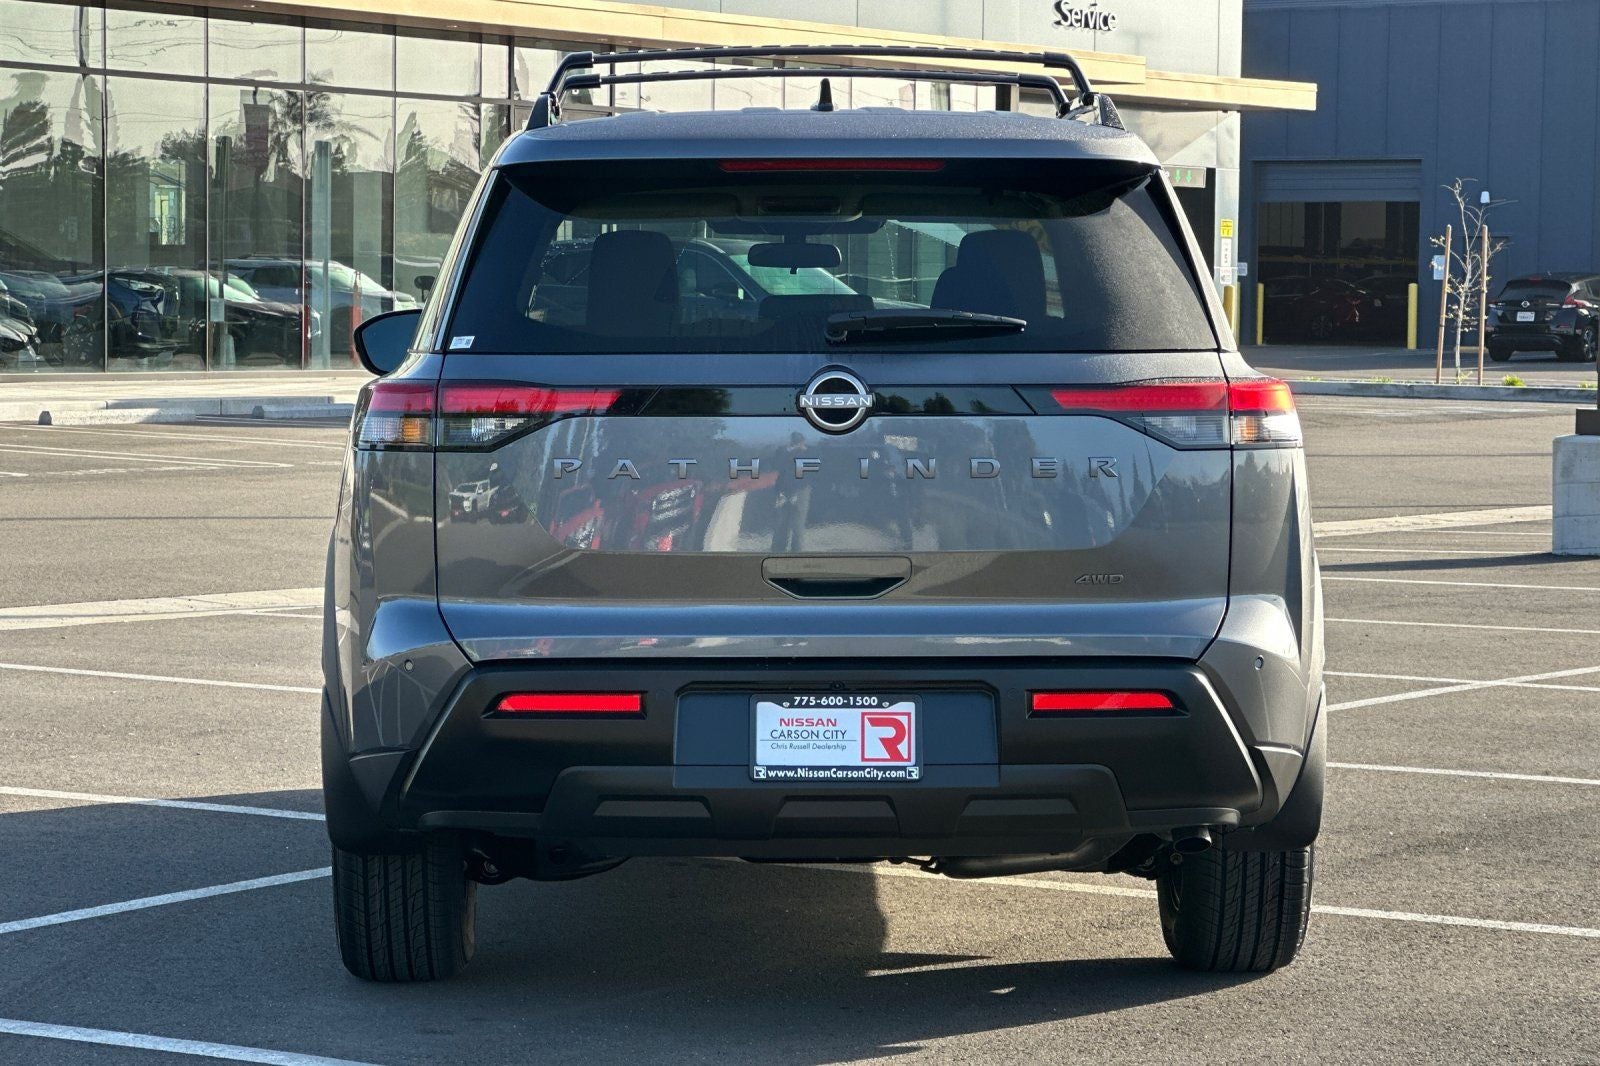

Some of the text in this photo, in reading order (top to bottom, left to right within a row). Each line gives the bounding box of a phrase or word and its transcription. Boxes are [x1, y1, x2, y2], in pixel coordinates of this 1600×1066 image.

[1053, 0, 1118, 31] Service
[801, 396, 871, 406] NISSAN
[553, 457, 1119, 479] PATHFINDER
[1074, 574, 1124, 584] 4WD
[793, 696, 878, 706] 775-600-1500
[779, 718, 837, 727] NISSAN
[770, 729, 848, 740] CARSON CITY
[770, 742, 848, 752] Chris Russell Dealership
[767, 767, 906, 780] www.NissanCarsonCity.com
